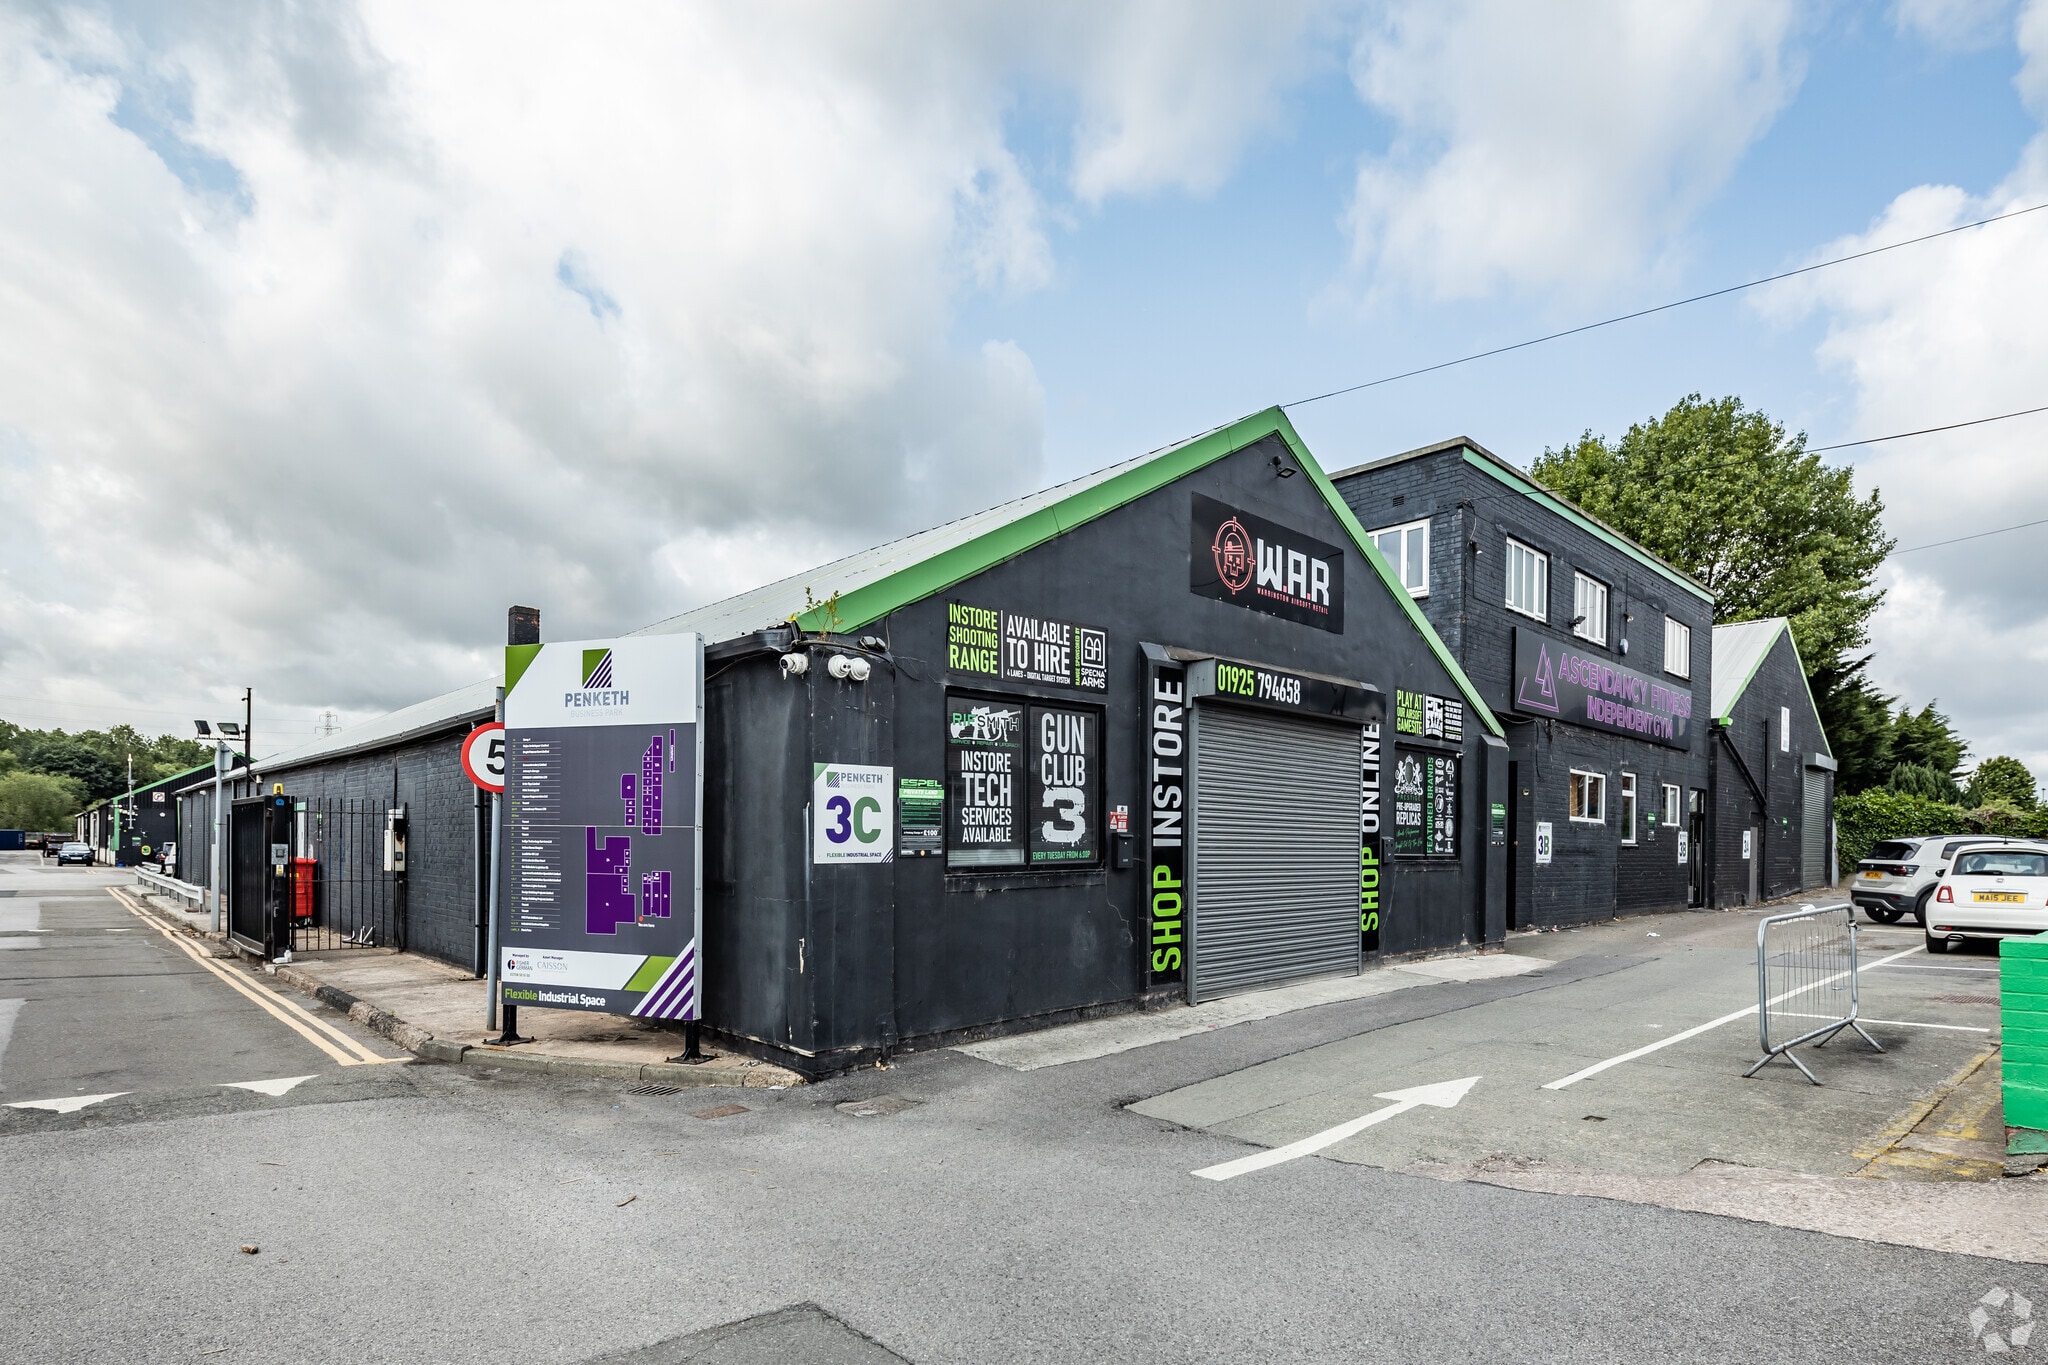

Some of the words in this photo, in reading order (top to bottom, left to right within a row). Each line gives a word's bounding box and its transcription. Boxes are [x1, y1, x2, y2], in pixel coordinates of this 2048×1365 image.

[1256, 587, 1289, 602] WARRINGTON
[1291, 598, 1311, 609] AIRSOFT
[1312, 604, 1329, 615] RETAIL
[950, 604, 998, 630] INSTORE
[950, 626, 998, 648] SHOOTING
[1007, 614, 1070, 645] AVAILABLE
[950, 644, 998, 674] RANGE
[1007, 637, 1027, 668] TO
[1034, 642, 1070, 675] HIRE
[1011, 669, 1023, 678] LANES
[1027, 672, 1041, 680] DIGITAL
[1042, 674, 1055, 682] TARGET
[1056, 676, 1070, 684] SYSTEM
[1081, 668, 1105, 678] SPECNA
[1081, 677, 1105, 689] ARMS
[1218, 664, 1254, 696] 01925
[1257, 672, 1300, 704] 794658
[1558, 652, 1648, 705] ASCENDANCY
[1651, 684, 1691, 719] FITNESS
[565, 690, 630, 708] PENKETH
[1397, 690, 1413, 708] PLAY
[1414, 694, 1422, 710] AT
[571, 710, 603, 718] BUSINESS
[1397, 706, 1405, 717] OUR
[1406, 708, 1422, 720] AIRSOFT
[1587, 694, 1653, 734] INDEPENDENT
[1653, 715, 1673, 740] GYM
[1042, 713, 1085, 754] GUN
[1397, 718, 1422, 734] GAMESITE
[962, 750, 1011, 772] INSTORE
[1042, 754, 1085, 786] CLUB
[1153, 678, 1182, 847] INSTORE
[841, 773, 882, 783] PENKETH
[1362, 724, 1380, 833] ONLINE
[962, 772, 1011, 807] TECH
[962, 807, 1012, 825] SERVICES
[1042, 787, 1085, 844] 3
[1396, 802, 1421, 811] PRE-UPGRADED
[826, 796, 881, 843] 3C
[1396, 811, 1421, 825] REPLICAS
[962, 827, 1011, 843] AVAILABLE
[1538, 835, 1549, 855] 3B
[1033, 852, 1046, 860] EVERY
[1047, 851, 1066, 860] TUESDAY
[1361, 847, 1379, 931] SHOP
[1152, 865, 1182, 972] SHOP
[537, 961, 568, 970] CAISSON
[505, 988, 537, 1000] Flexible
[538, 991, 578, 1004] Industrial
[580, 994, 606, 1006] Space
